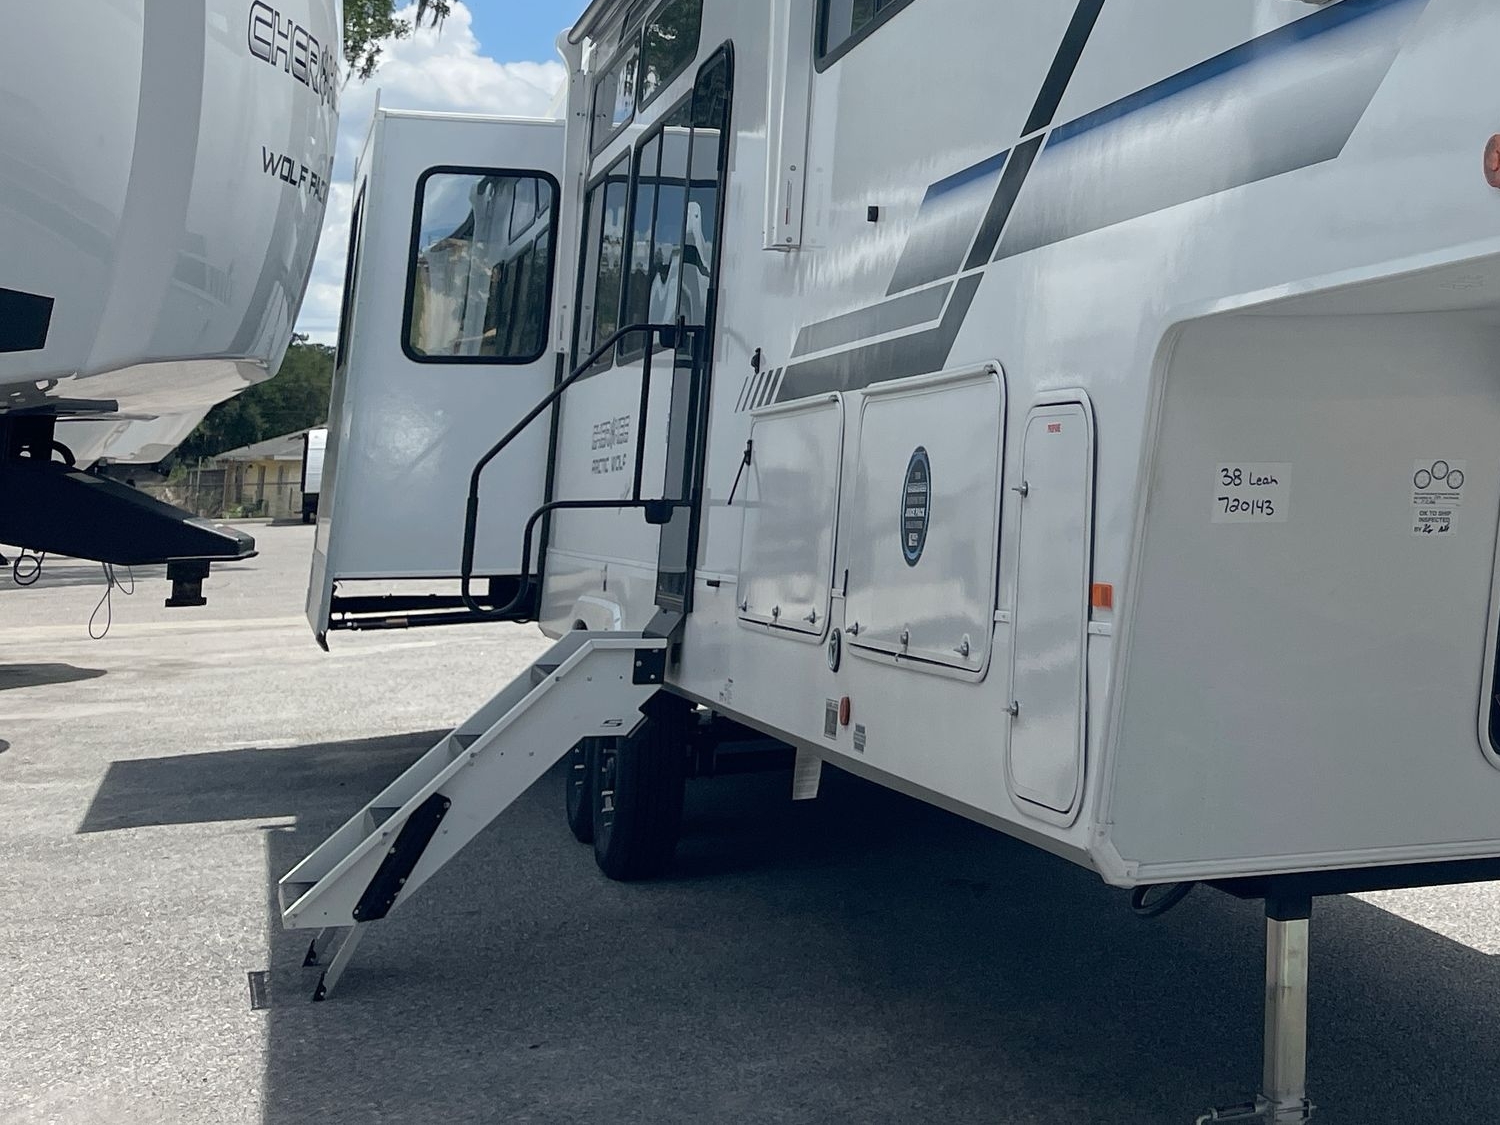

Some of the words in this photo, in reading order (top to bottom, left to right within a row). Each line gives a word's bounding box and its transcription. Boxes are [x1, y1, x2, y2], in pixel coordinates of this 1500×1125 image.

[262, 146, 309, 189] WOLF
[1221, 468, 1242, 486] 38
[1218, 497, 1275, 516] 720143
